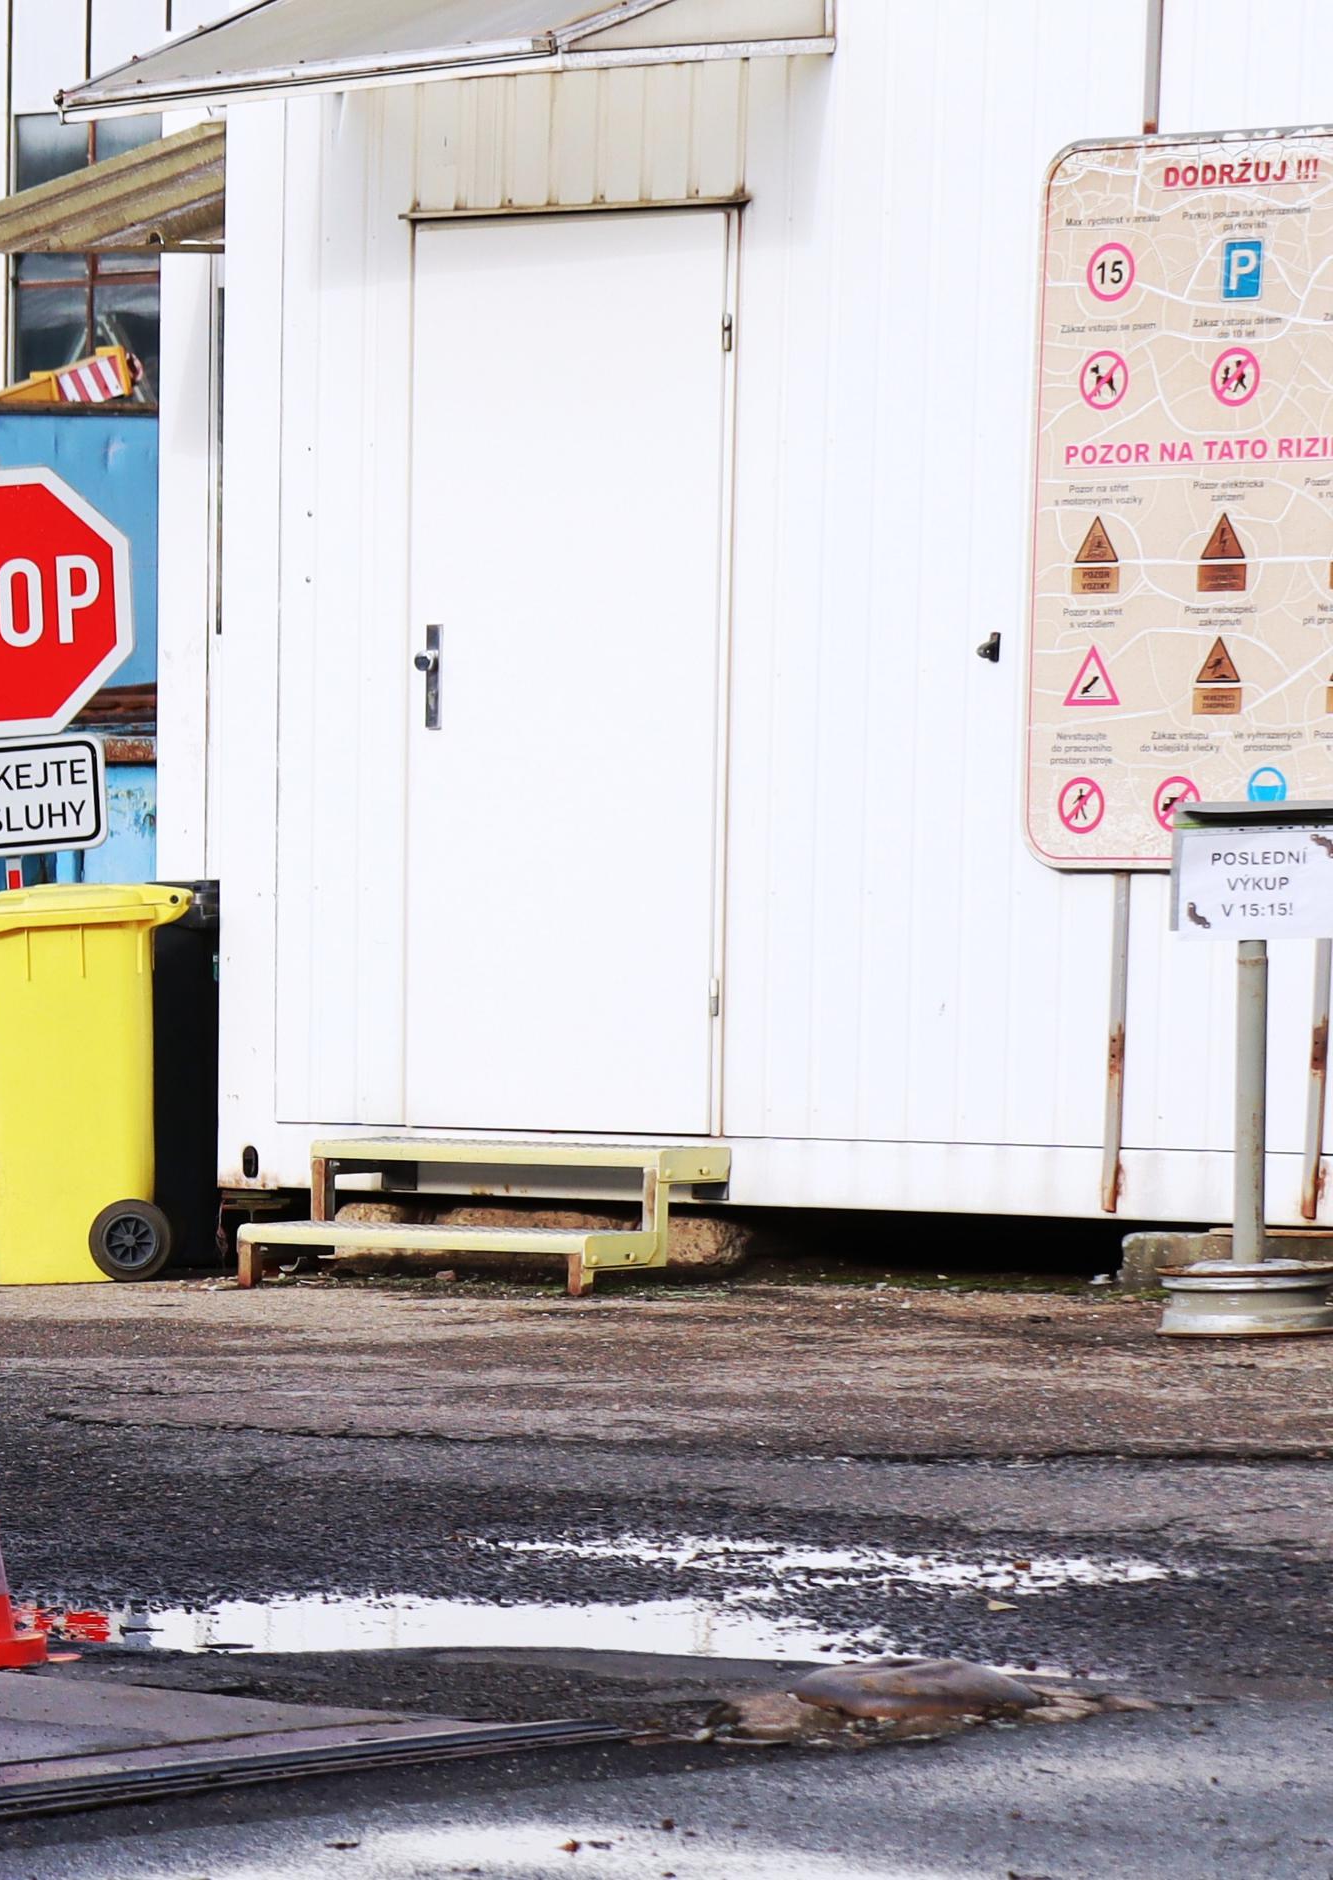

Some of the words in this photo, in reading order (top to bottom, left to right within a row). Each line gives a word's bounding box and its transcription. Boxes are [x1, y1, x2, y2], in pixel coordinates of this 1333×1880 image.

[1164, 157, 1287, 187] DODRŽUJ
[1297, 158, 1318, 180] !!!
[1213, 210, 1240, 219] pouze
[1243, 209, 1253, 217] na
[1088, 215, 1124, 227] rychlost
[1096, 260, 1123, 285] 15
[1229, 249, 1257, 290] P
[1060, 323, 1085, 334] Zákaz
[1088, 323, 1118, 333] vstupu
[1133, 322, 1156, 331] psem
[1193, 318, 1218, 328] Zákaz
[1222, 318, 1252, 327] vstupu
[1217, 330, 1229, 338] do
[1245, 329, 1255, 338] let
[1064, 443, 1149, 465] POZOR
[1159, 441, 1193, 462] NA
[1203, 439, 1268, 461] TATO
[1278, 437, 1333, 458] RIZI
[1069, 484, 1094, 494] Pozor
[1193, 481, 1218, 490] Pozor
[1082, 570, 1110, 579] POZOR
[1063, 608, 1088, 616] Pozor
[1185, 605, 1209, 614] Pozor
[1056, 732, 1107, 742] Nevstupujte
[1151, 731, 1177, 740] Zákaz
[1179, 731, 1209, 741] vstupu
[1051, 744, 1062, 752] do
[1139, 744, 1151, 752] do
[1243, 744, 1292, 753] prostorech
[1050, 757, 1086, 766] prostoru
[1089, 757, 1112, 767] stroje
[1211, 847, 1308, 866] POSLEDNÍ
[1226, 874, 1289, 891] VÝKUP
[1221, 904, 1234, 917] V
[1240, 902, 1294, 917] 15:15!
